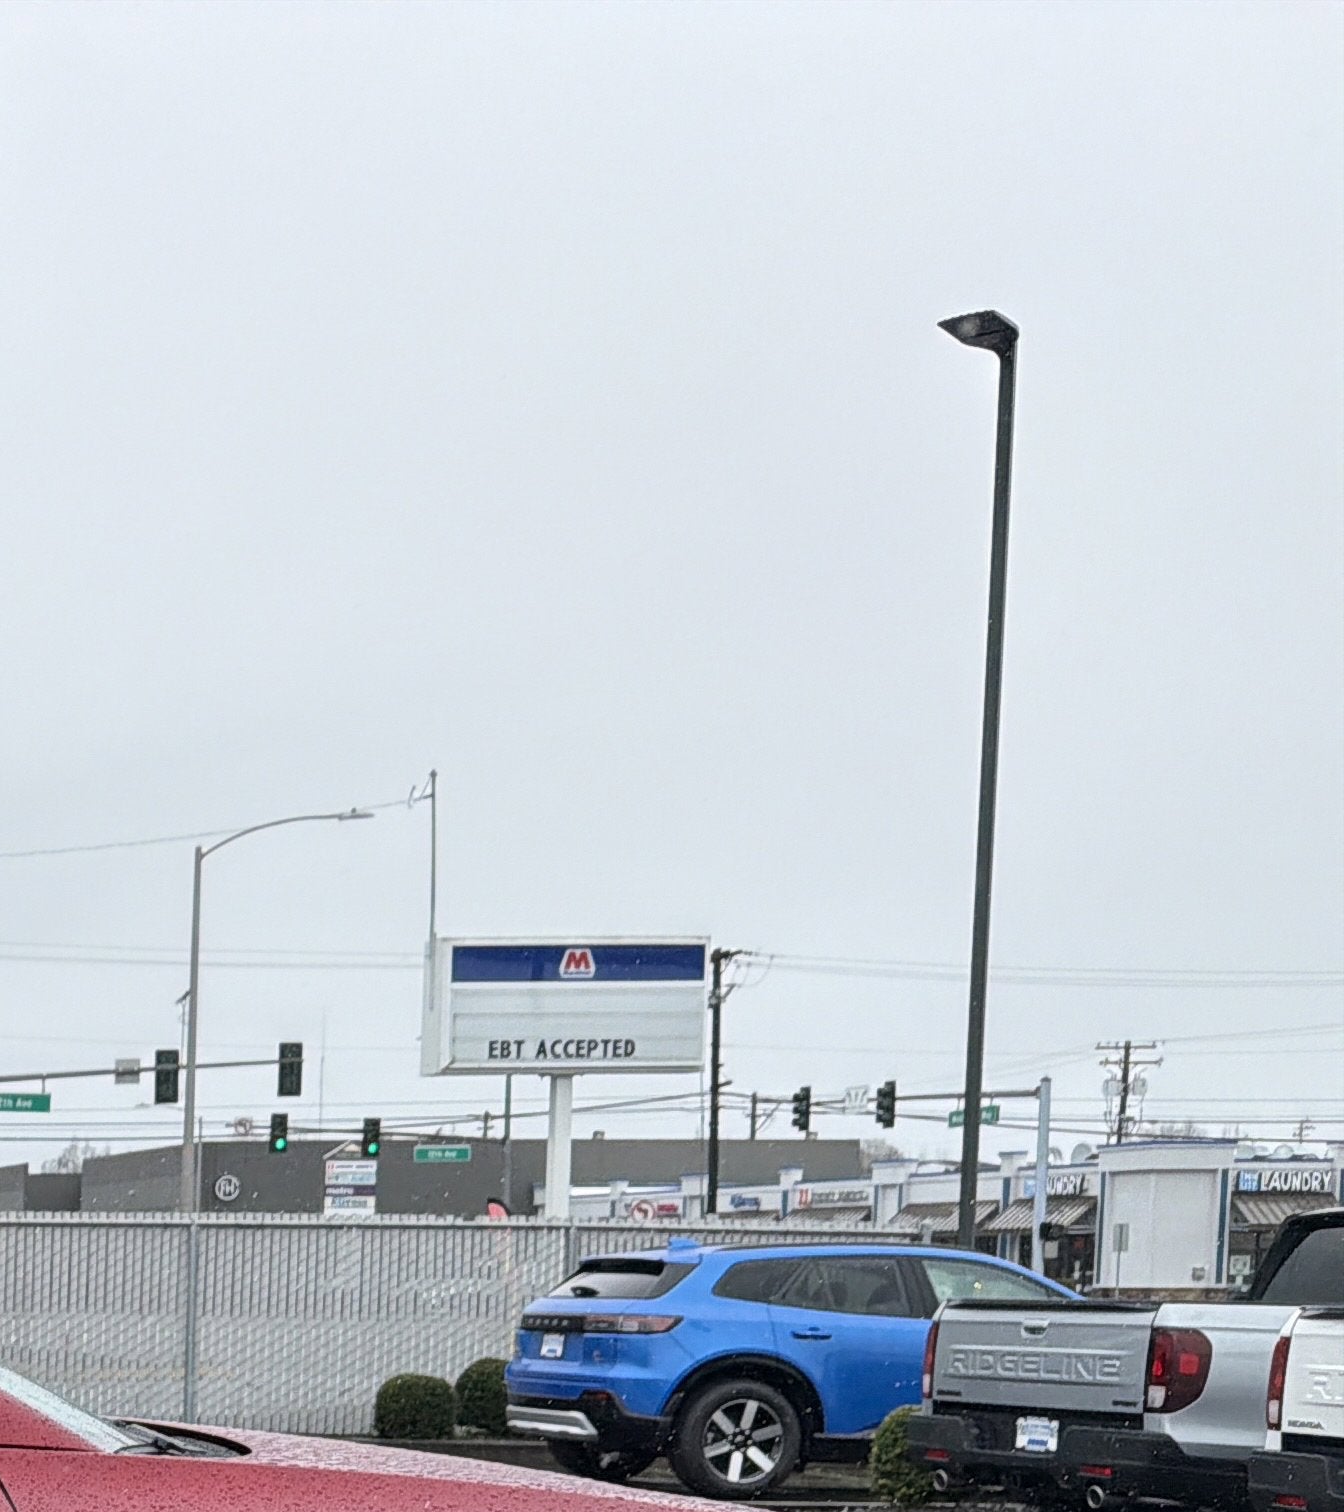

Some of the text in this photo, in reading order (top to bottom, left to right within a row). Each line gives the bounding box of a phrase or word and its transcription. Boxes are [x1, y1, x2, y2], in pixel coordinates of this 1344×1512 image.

[488, 1038, 636, 1060] EBT ACCEPTED
[1047, 1174, 1084, 1196] UNDRY
[1261, 1170, 1332, 1193] LAUNDRY
[945, 1352, 1121, 1382] RIDGELINE
